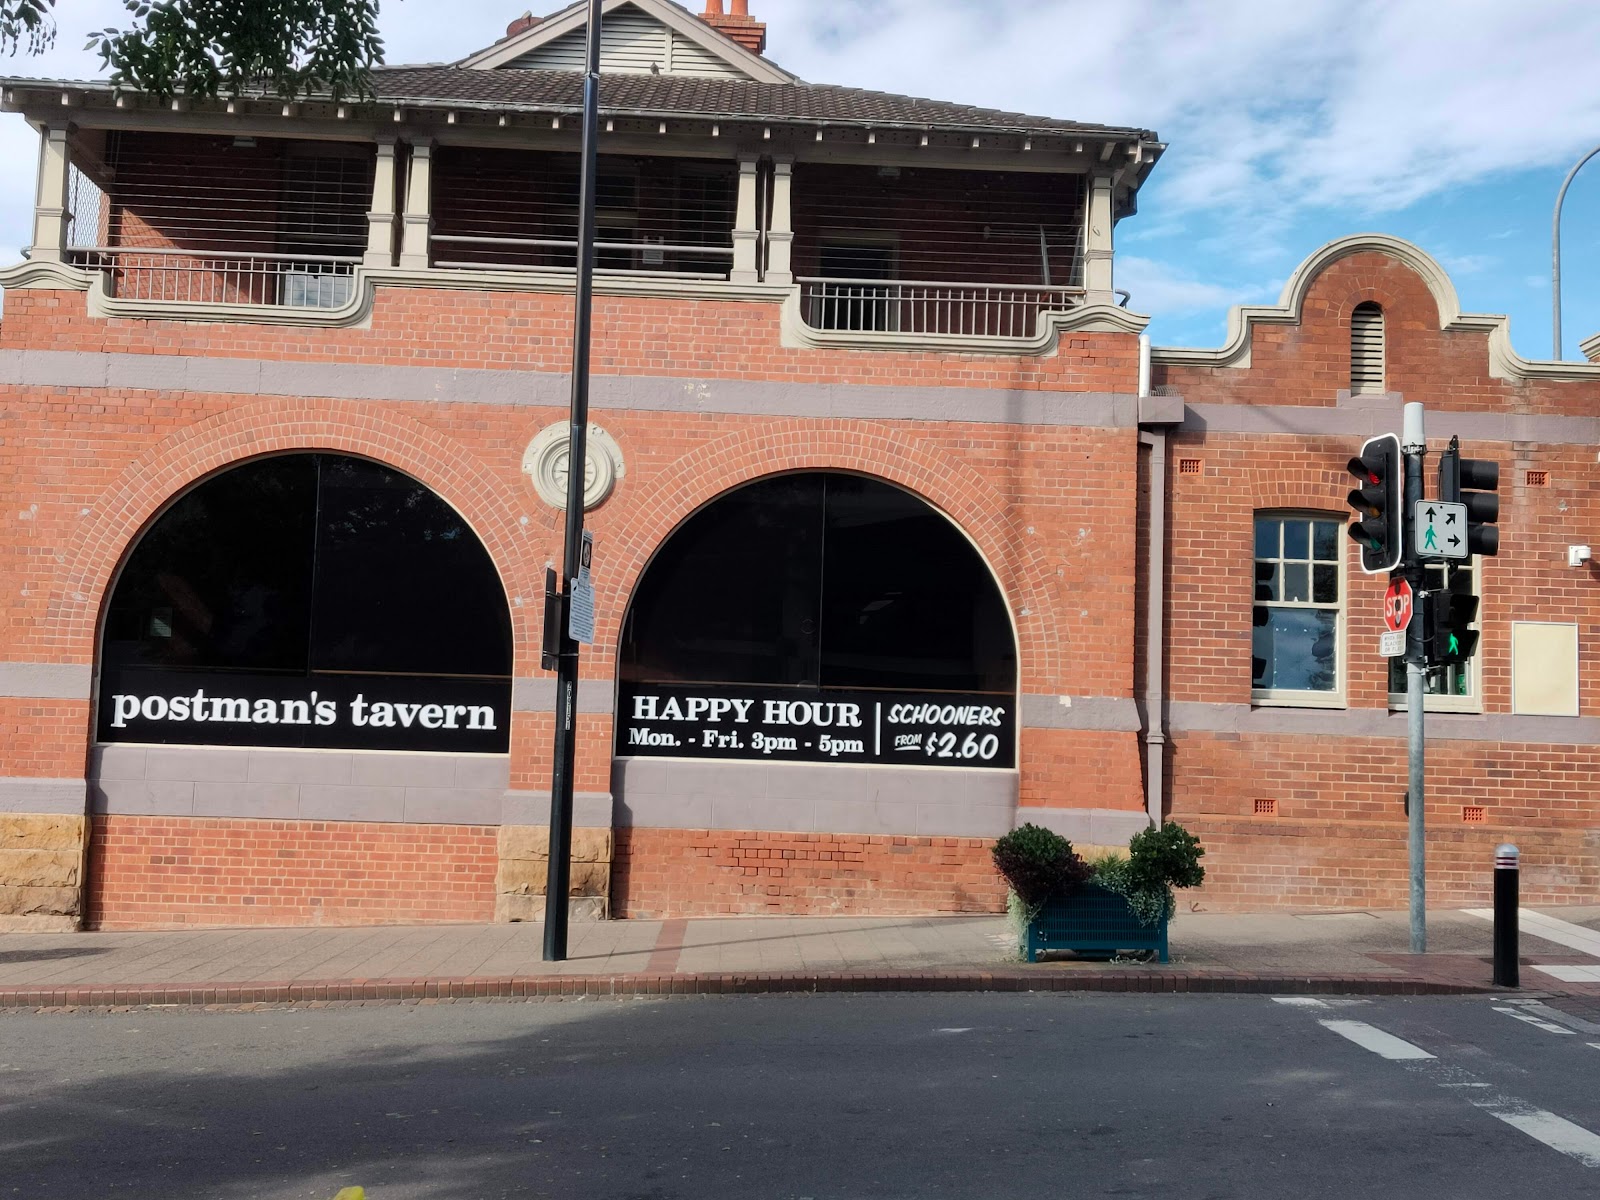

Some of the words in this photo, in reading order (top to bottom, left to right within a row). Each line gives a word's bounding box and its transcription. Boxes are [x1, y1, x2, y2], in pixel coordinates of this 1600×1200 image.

[1386, 594, 1410, 617] STOP
[111, 689, 337, 728] postman's
[350, 693, 497, 730] tavern
[632, 696, 754, 723] HAPPY
[762, 700, 863, 728] HOUR
[887, 703, 1006, 727] SCHOONERS
[628, 728, 682, 747] Mon.
[702, 730, 745, 749] Fri.
[751, 732, 798, 754] 3pm
[818, 734, 865, 757] 5pm
[894, 733, 922, 747] FROM
[925, 732, 999, 760] $2.60
